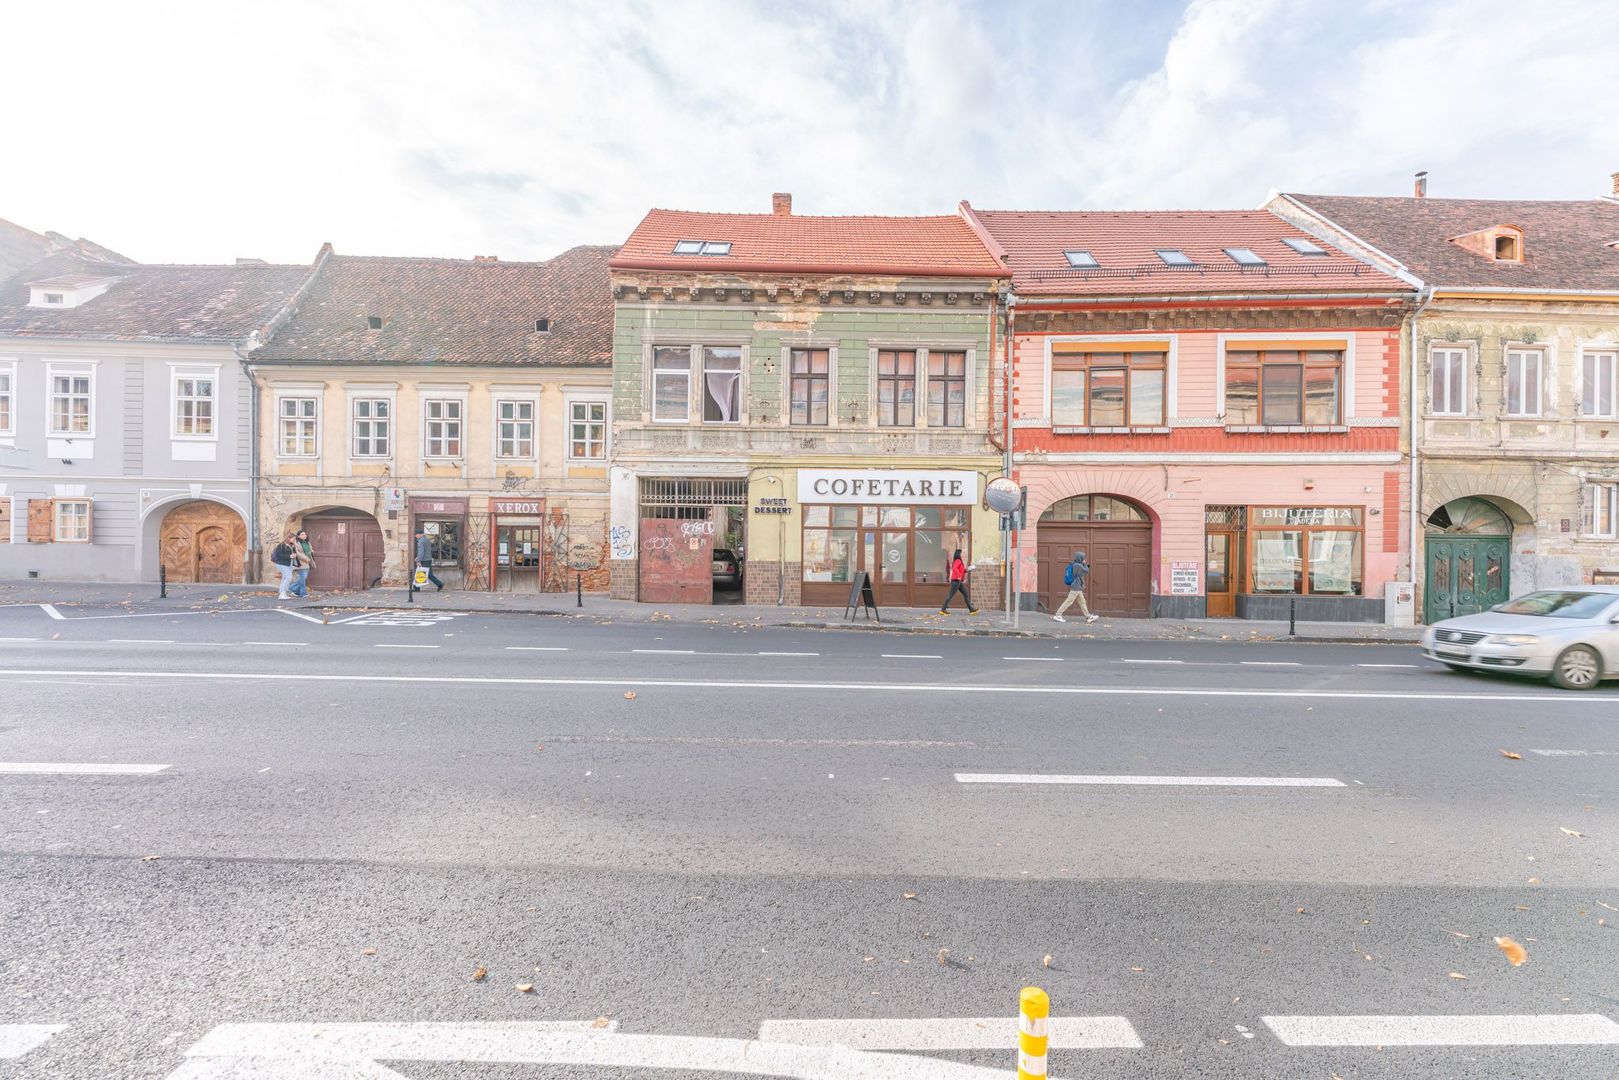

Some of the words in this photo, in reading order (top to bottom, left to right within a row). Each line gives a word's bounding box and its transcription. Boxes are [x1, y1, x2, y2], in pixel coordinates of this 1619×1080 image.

[813, 478, 963, 497] COFETARIE
[496, 502, 539, 513] XEROX
[754, 506, 792, 515] DESSERT
[1262, 509, 1352, 518] BIJUTERIA
